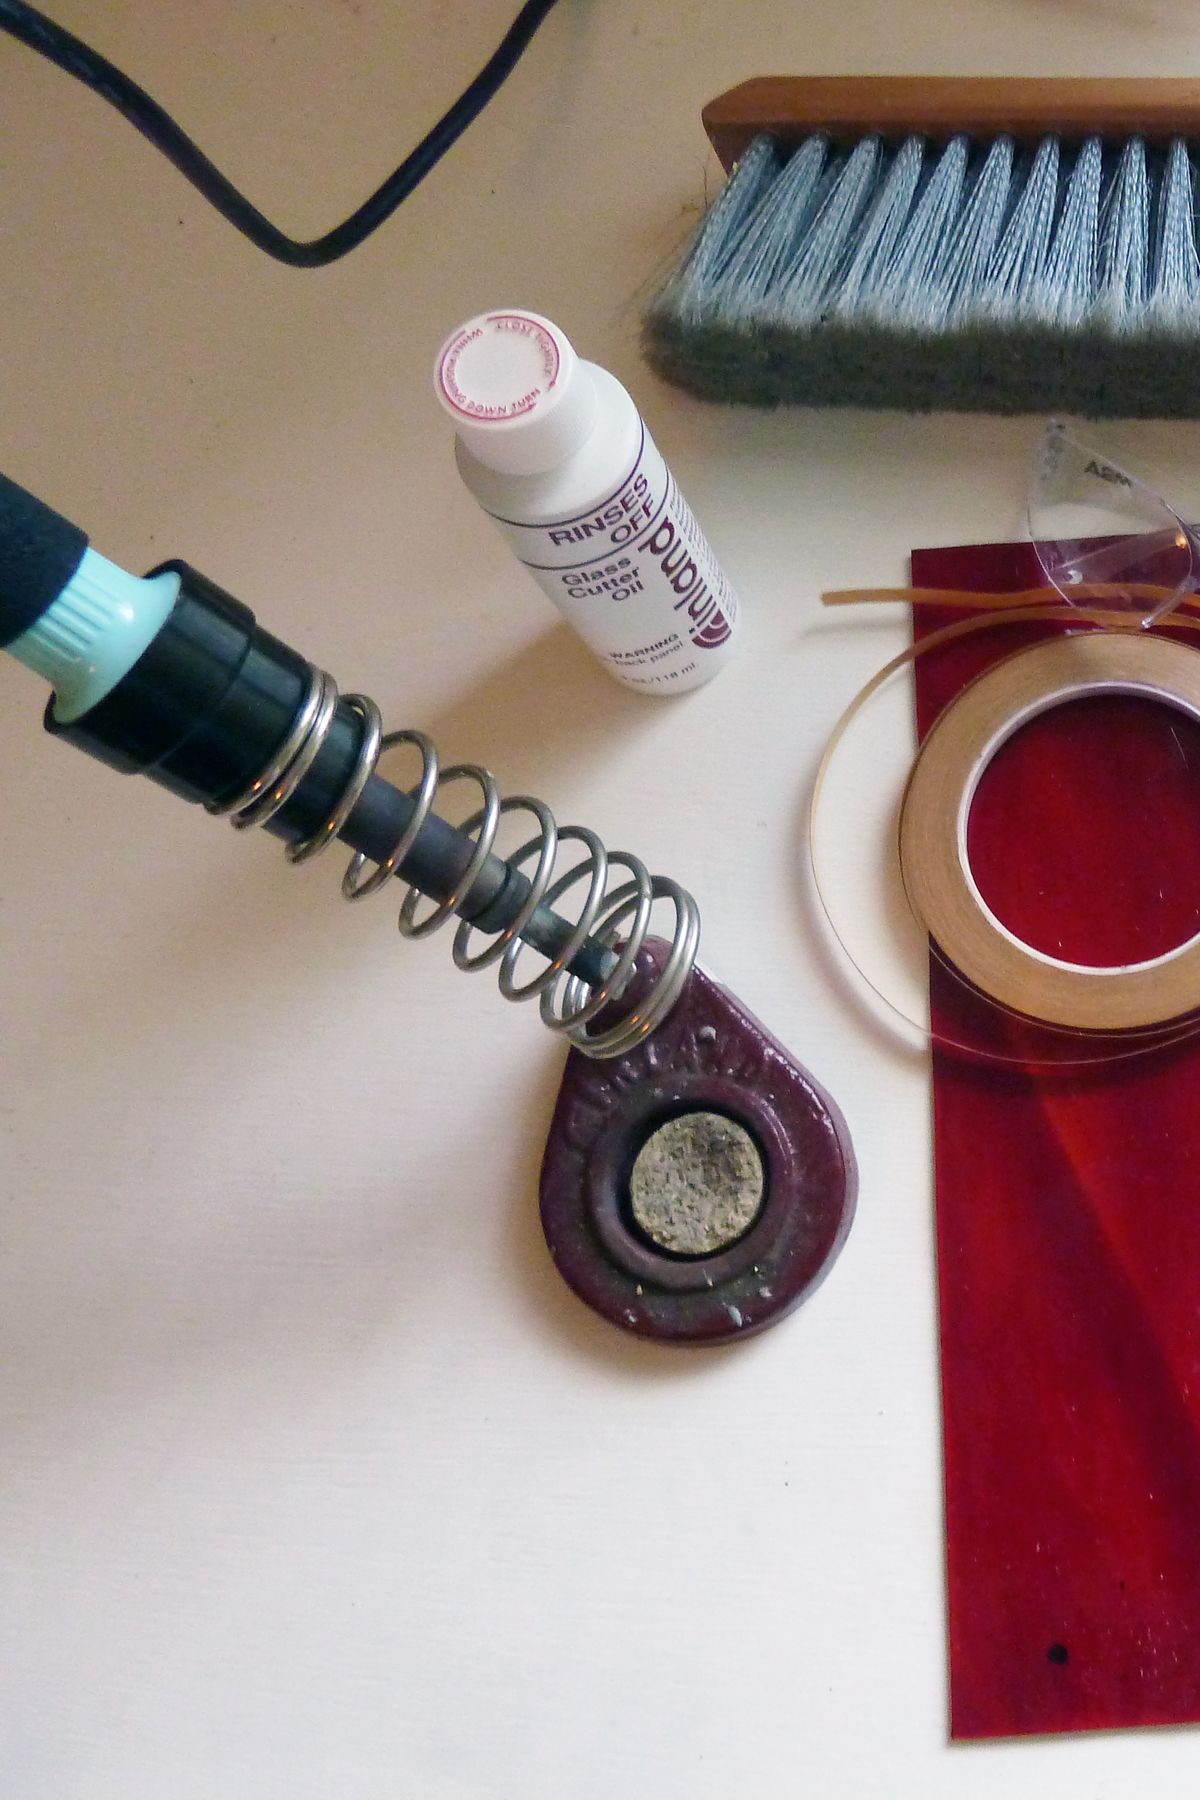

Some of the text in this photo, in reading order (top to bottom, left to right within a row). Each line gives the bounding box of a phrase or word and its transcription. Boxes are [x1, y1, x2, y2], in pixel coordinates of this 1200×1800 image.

[467, 401, 507, 415] DOWN
[511, 388, 541, 410] TURN
[549, 473, 649, 547] RINSES
[610, 493, 655, 544] OFF
[561, 557, 632, 587] Glass
[567, 567, 640, 600] Cutter
[611, 580, 645, 602] Oil
[609, 633, 680, 660] WARNING
[650, 640, 684, 664] panel
